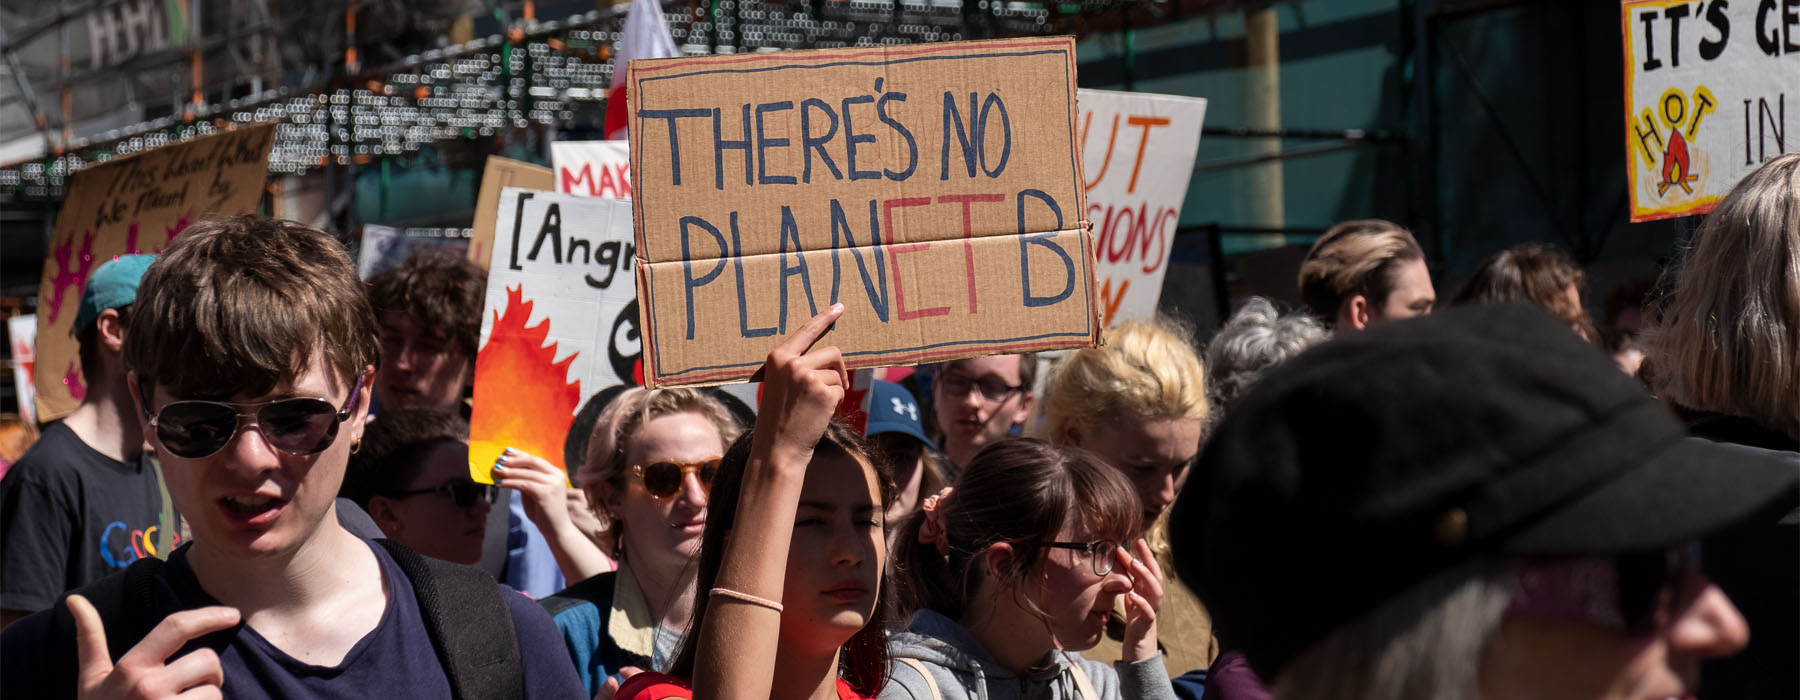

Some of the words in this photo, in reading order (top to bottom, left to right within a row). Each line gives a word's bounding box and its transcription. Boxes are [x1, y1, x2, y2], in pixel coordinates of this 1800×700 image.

[1640, 0, 1730, 71] IT'S
[638, 77, 918, 190] THERE'S
[940, 91, 1012, 181] NO
[1635, 93, 1713, 163] HOT
[1744, 93, 1784, 165] IN
[680, 194, 1005, 340] PLANET
[1017, 189, 1076, 307] B
